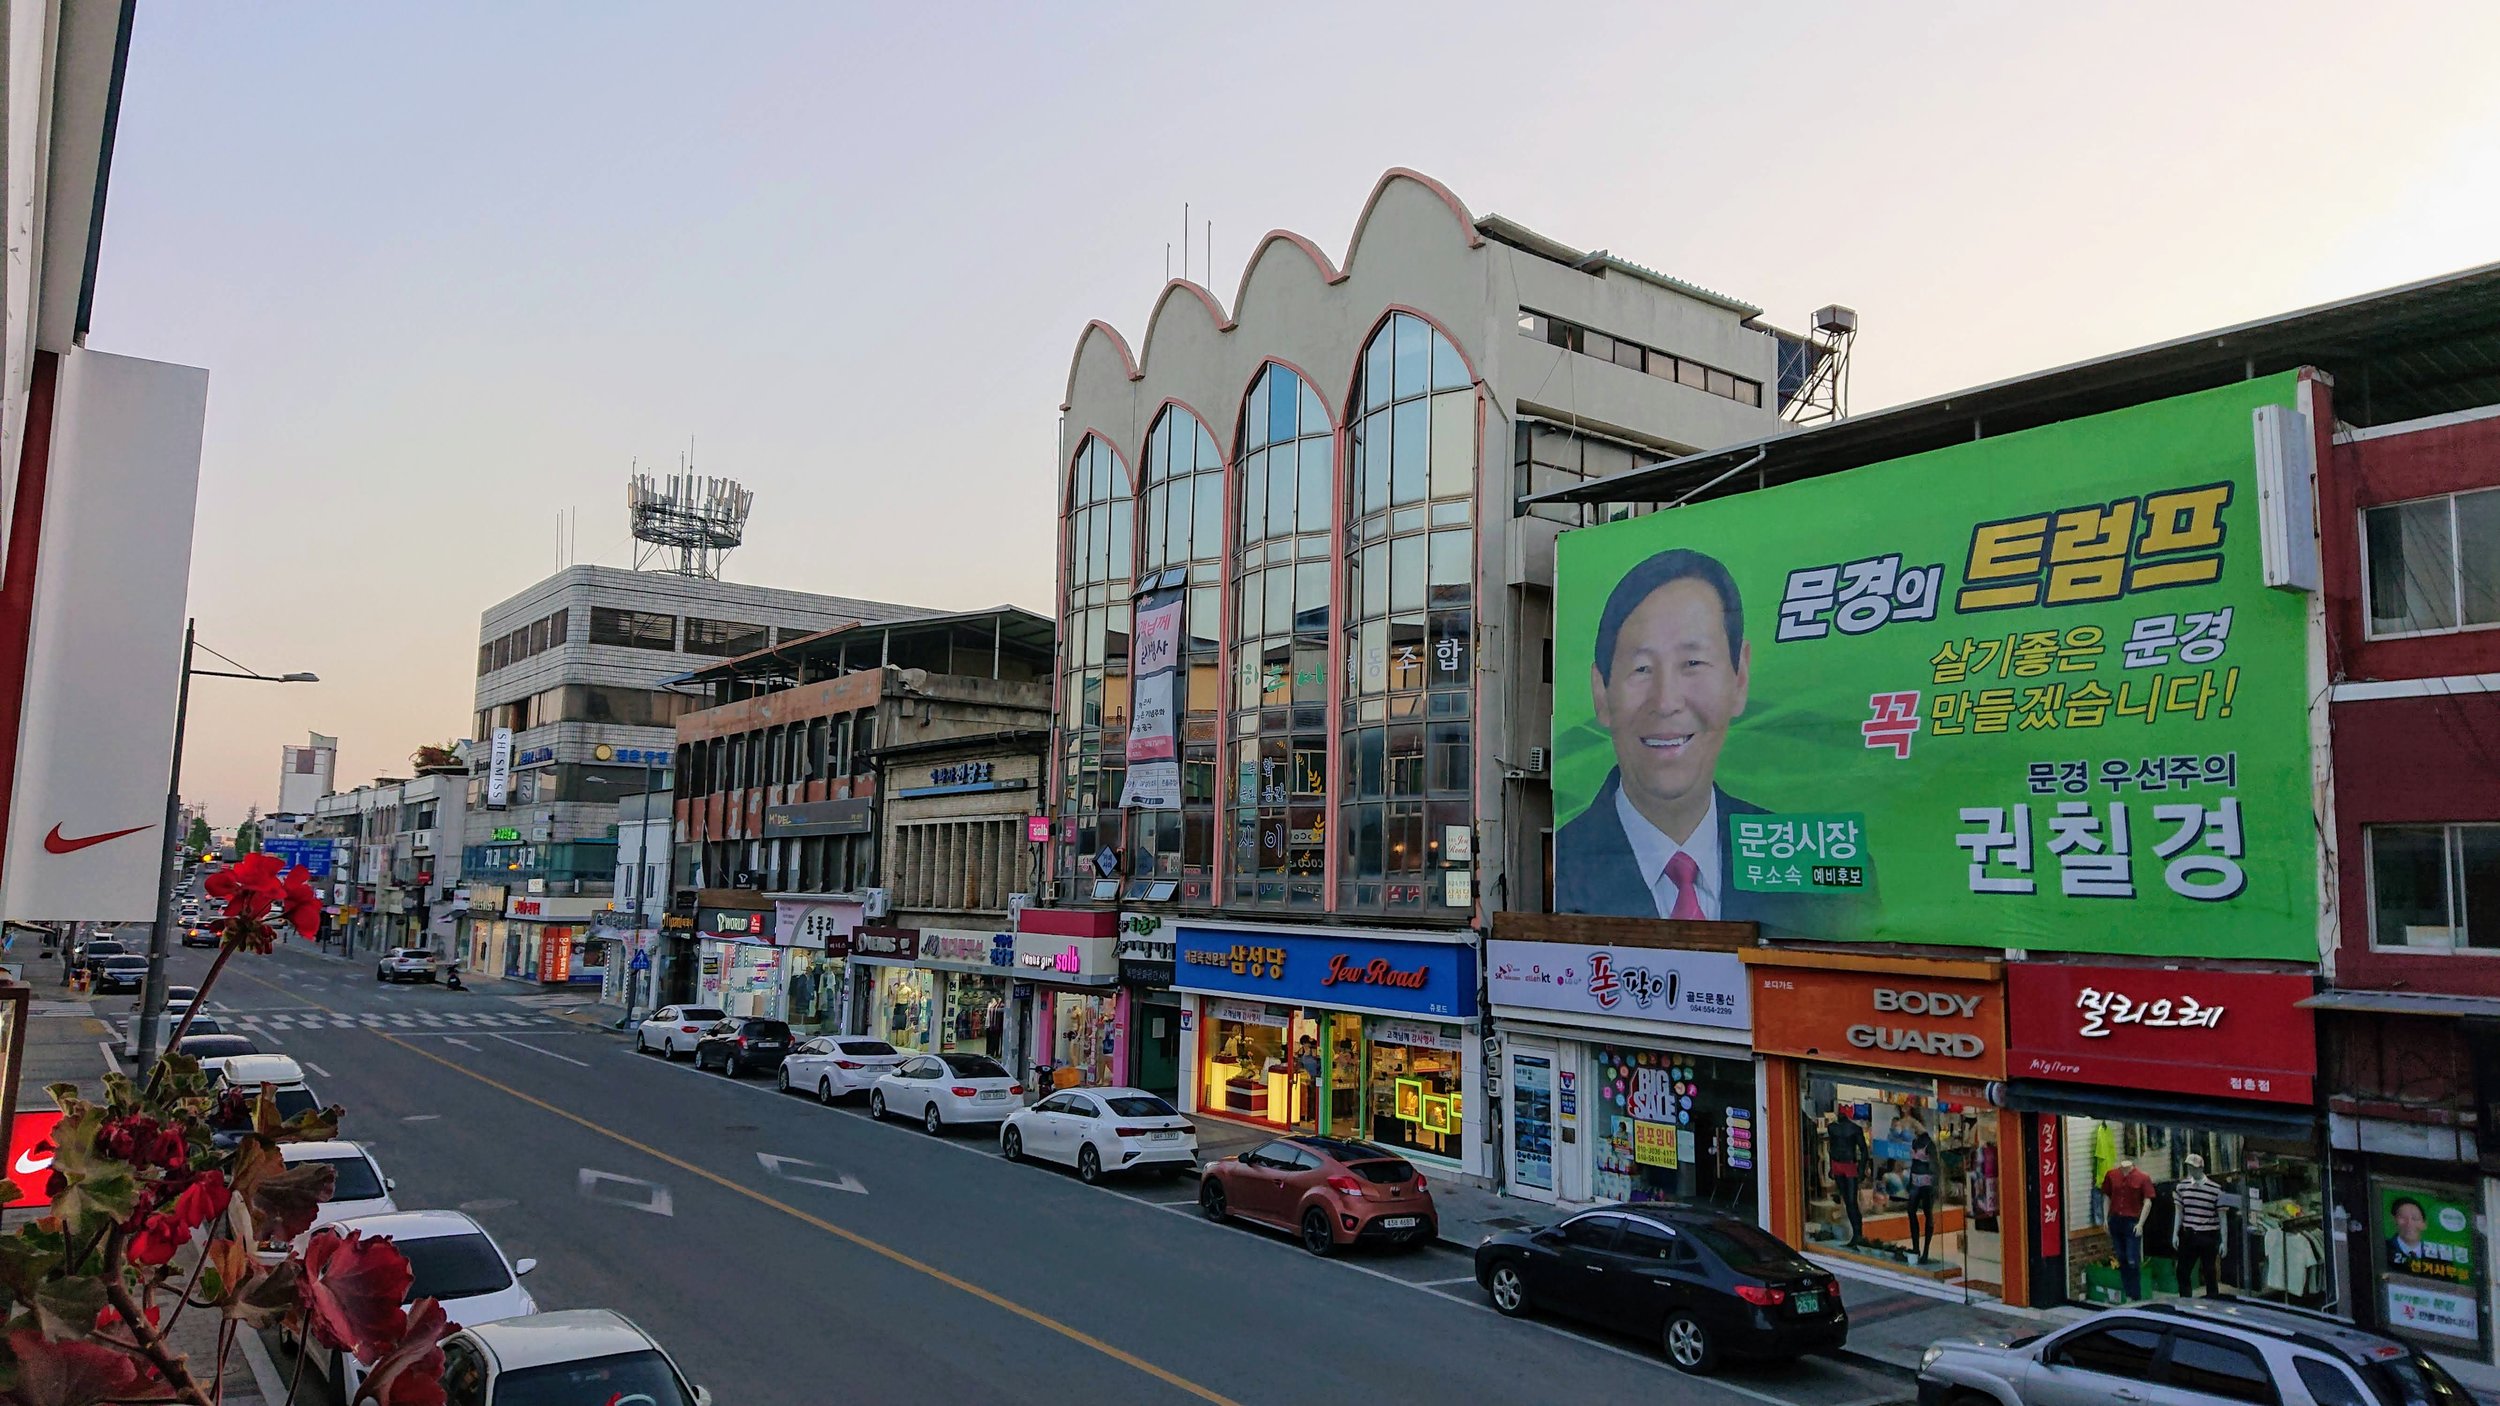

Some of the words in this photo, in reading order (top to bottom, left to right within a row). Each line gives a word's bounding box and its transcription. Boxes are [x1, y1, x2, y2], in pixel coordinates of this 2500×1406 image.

[1777, 555, 1941, 642] 문경의
[1957, 481, 2234, 612] 트럼프
[1931, 626, 2105, 683] 살기좋은
[2121, 608, 2234, 667] 문경
[1861, 690, 1920, 758] 꼭
[1931, 667, 2239, 735] 만들겠습니다!
[493, 733, 507, 799] SHESMISS
[2028, 760, 2090, 793] 문경
[2099, 753, 2237, 790] 우선주의
[1737, 819, 1859, 858] 문경시장
[1955, 797, 2247, 900] 권칠경
[1746, 864, 1802, 887] 무소속
[1813, 866, 1863, 887] 예비후보
[1055, 945, 1081, 974] solb
[1228, 944, 1287, 979] 삼성당
[1321, 953, 1365, 986] Jew
[1363, 957, 1430, 990] Road
[1541, 972, 1551, 984] kt
[1763, 980, 1795, 990] 보디가드
[1873, 988, 1984, 1019] BODY
[2076, 987, 2225, 1038] 밀리오레
[1386, 1030, 1411, 1042] 고객님께
[1411, 1034, 1436, 1045] 감사행사
[1846, 1024, 1985, 1060] GUARD
[1638, 1067, 1670, 1096] BIG
[1634, 1091, 1677, 1124] SALE
[1636, 1125, 1675, 1148] 점포임대
[2042, 1123, 2058, 1224] 밀리오레
